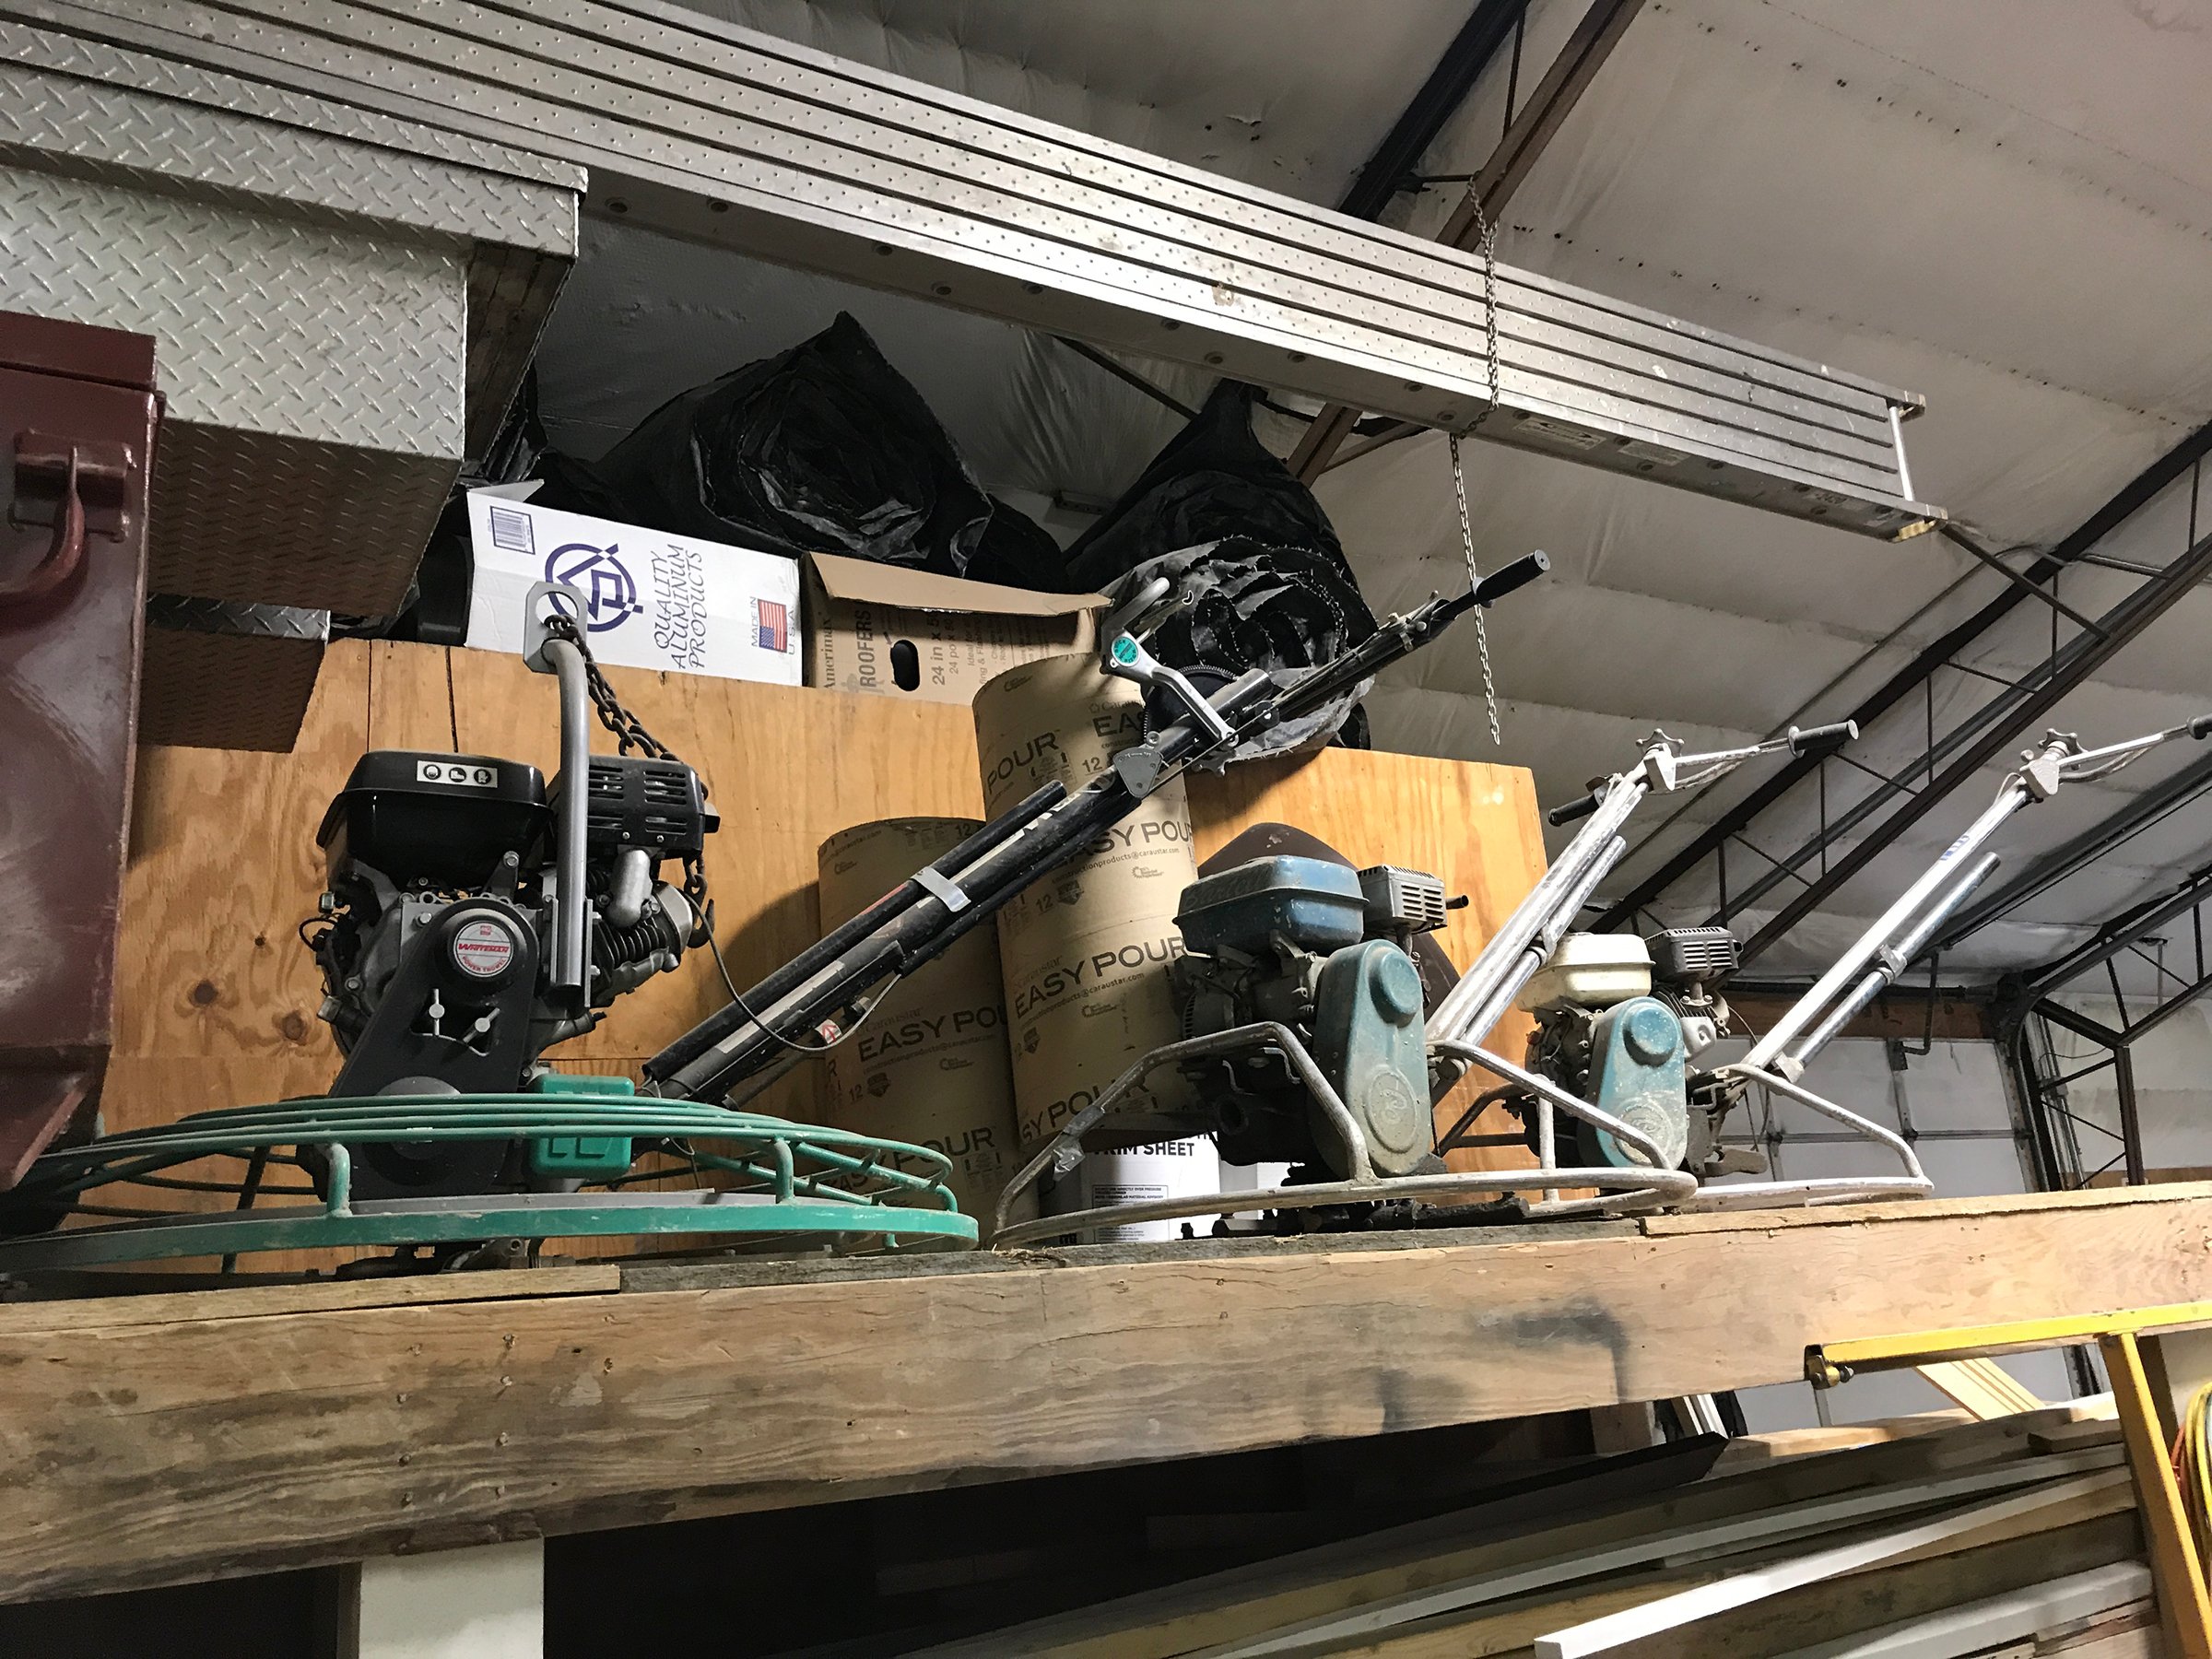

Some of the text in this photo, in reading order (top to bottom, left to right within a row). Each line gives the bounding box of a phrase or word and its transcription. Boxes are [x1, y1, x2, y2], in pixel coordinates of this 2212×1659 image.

[650, 550, 671, 649] QUALITY
[666, 544, 690, 669] ALUMINUM
[685, 549, 708, 668] PRODUCTS
[749, 596, 757, 609] IN
[931, 631, 941, 641] x
[854, 609, 877, 688] ROOFERS
[931, 646, 943, 661] in
[949, 643, 959, 658] po
[966, 644, 975, 666] Ideal
[932, 665, 945, 686] 24
[949, 662, 959, 675] 24
[987, 732, 1059, 795] POUR
[1081, 757, 1102, 772] 12
[1035, 893, 1053, 913] 12
[458, 943, 510, 953] WHITEMAN
[462, 955, 507, 973] POWER TROWEL
[1015, 935, 1187, 1019] EASY POUR
[858, 1016, 947, 1063] EASY
[849, 1084, 864, 1102] 12
[1143, 1142, 1194, 1157] SHEET
